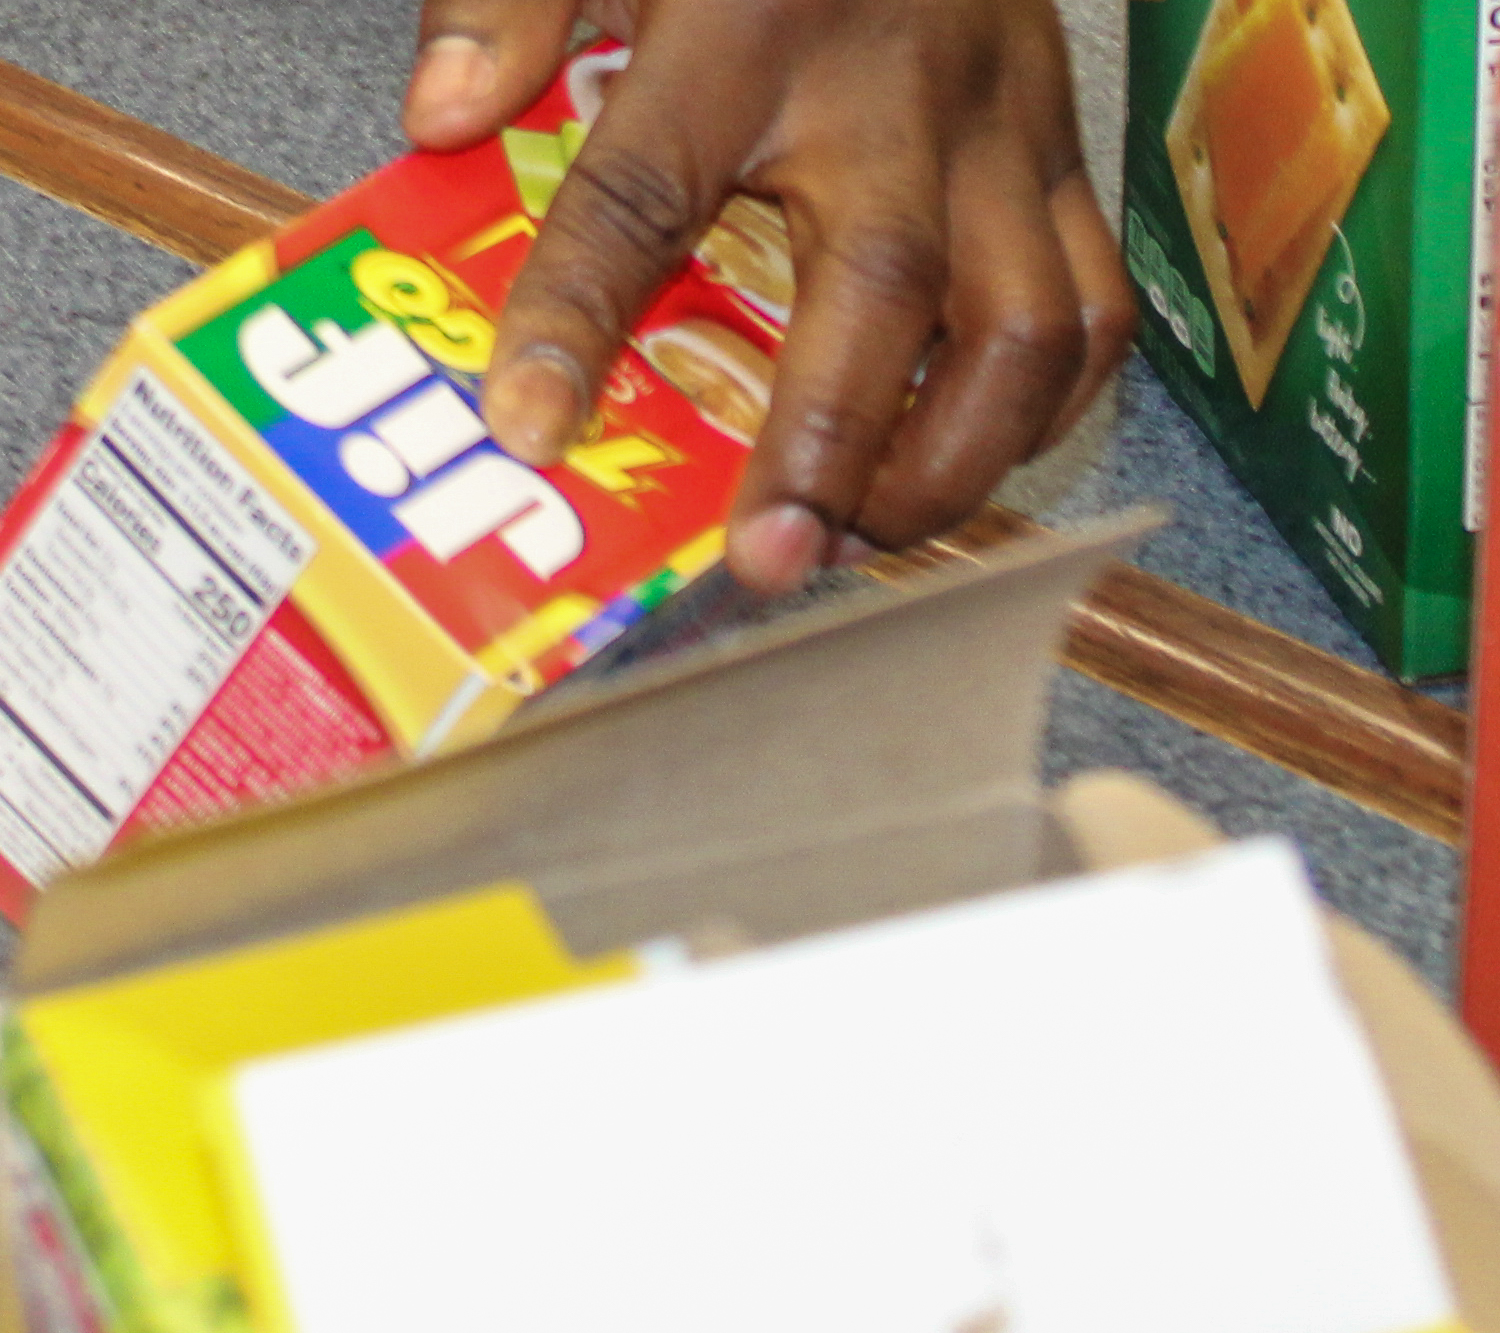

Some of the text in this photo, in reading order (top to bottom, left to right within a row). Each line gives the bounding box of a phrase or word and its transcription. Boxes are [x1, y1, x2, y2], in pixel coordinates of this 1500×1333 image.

[133, 379, 302, 564] Nutrition Facts
[237, 302, 586, 583] Jif
[350, 248, 688, 499] T GO
[80, 459, 254, 641] Calories 250
